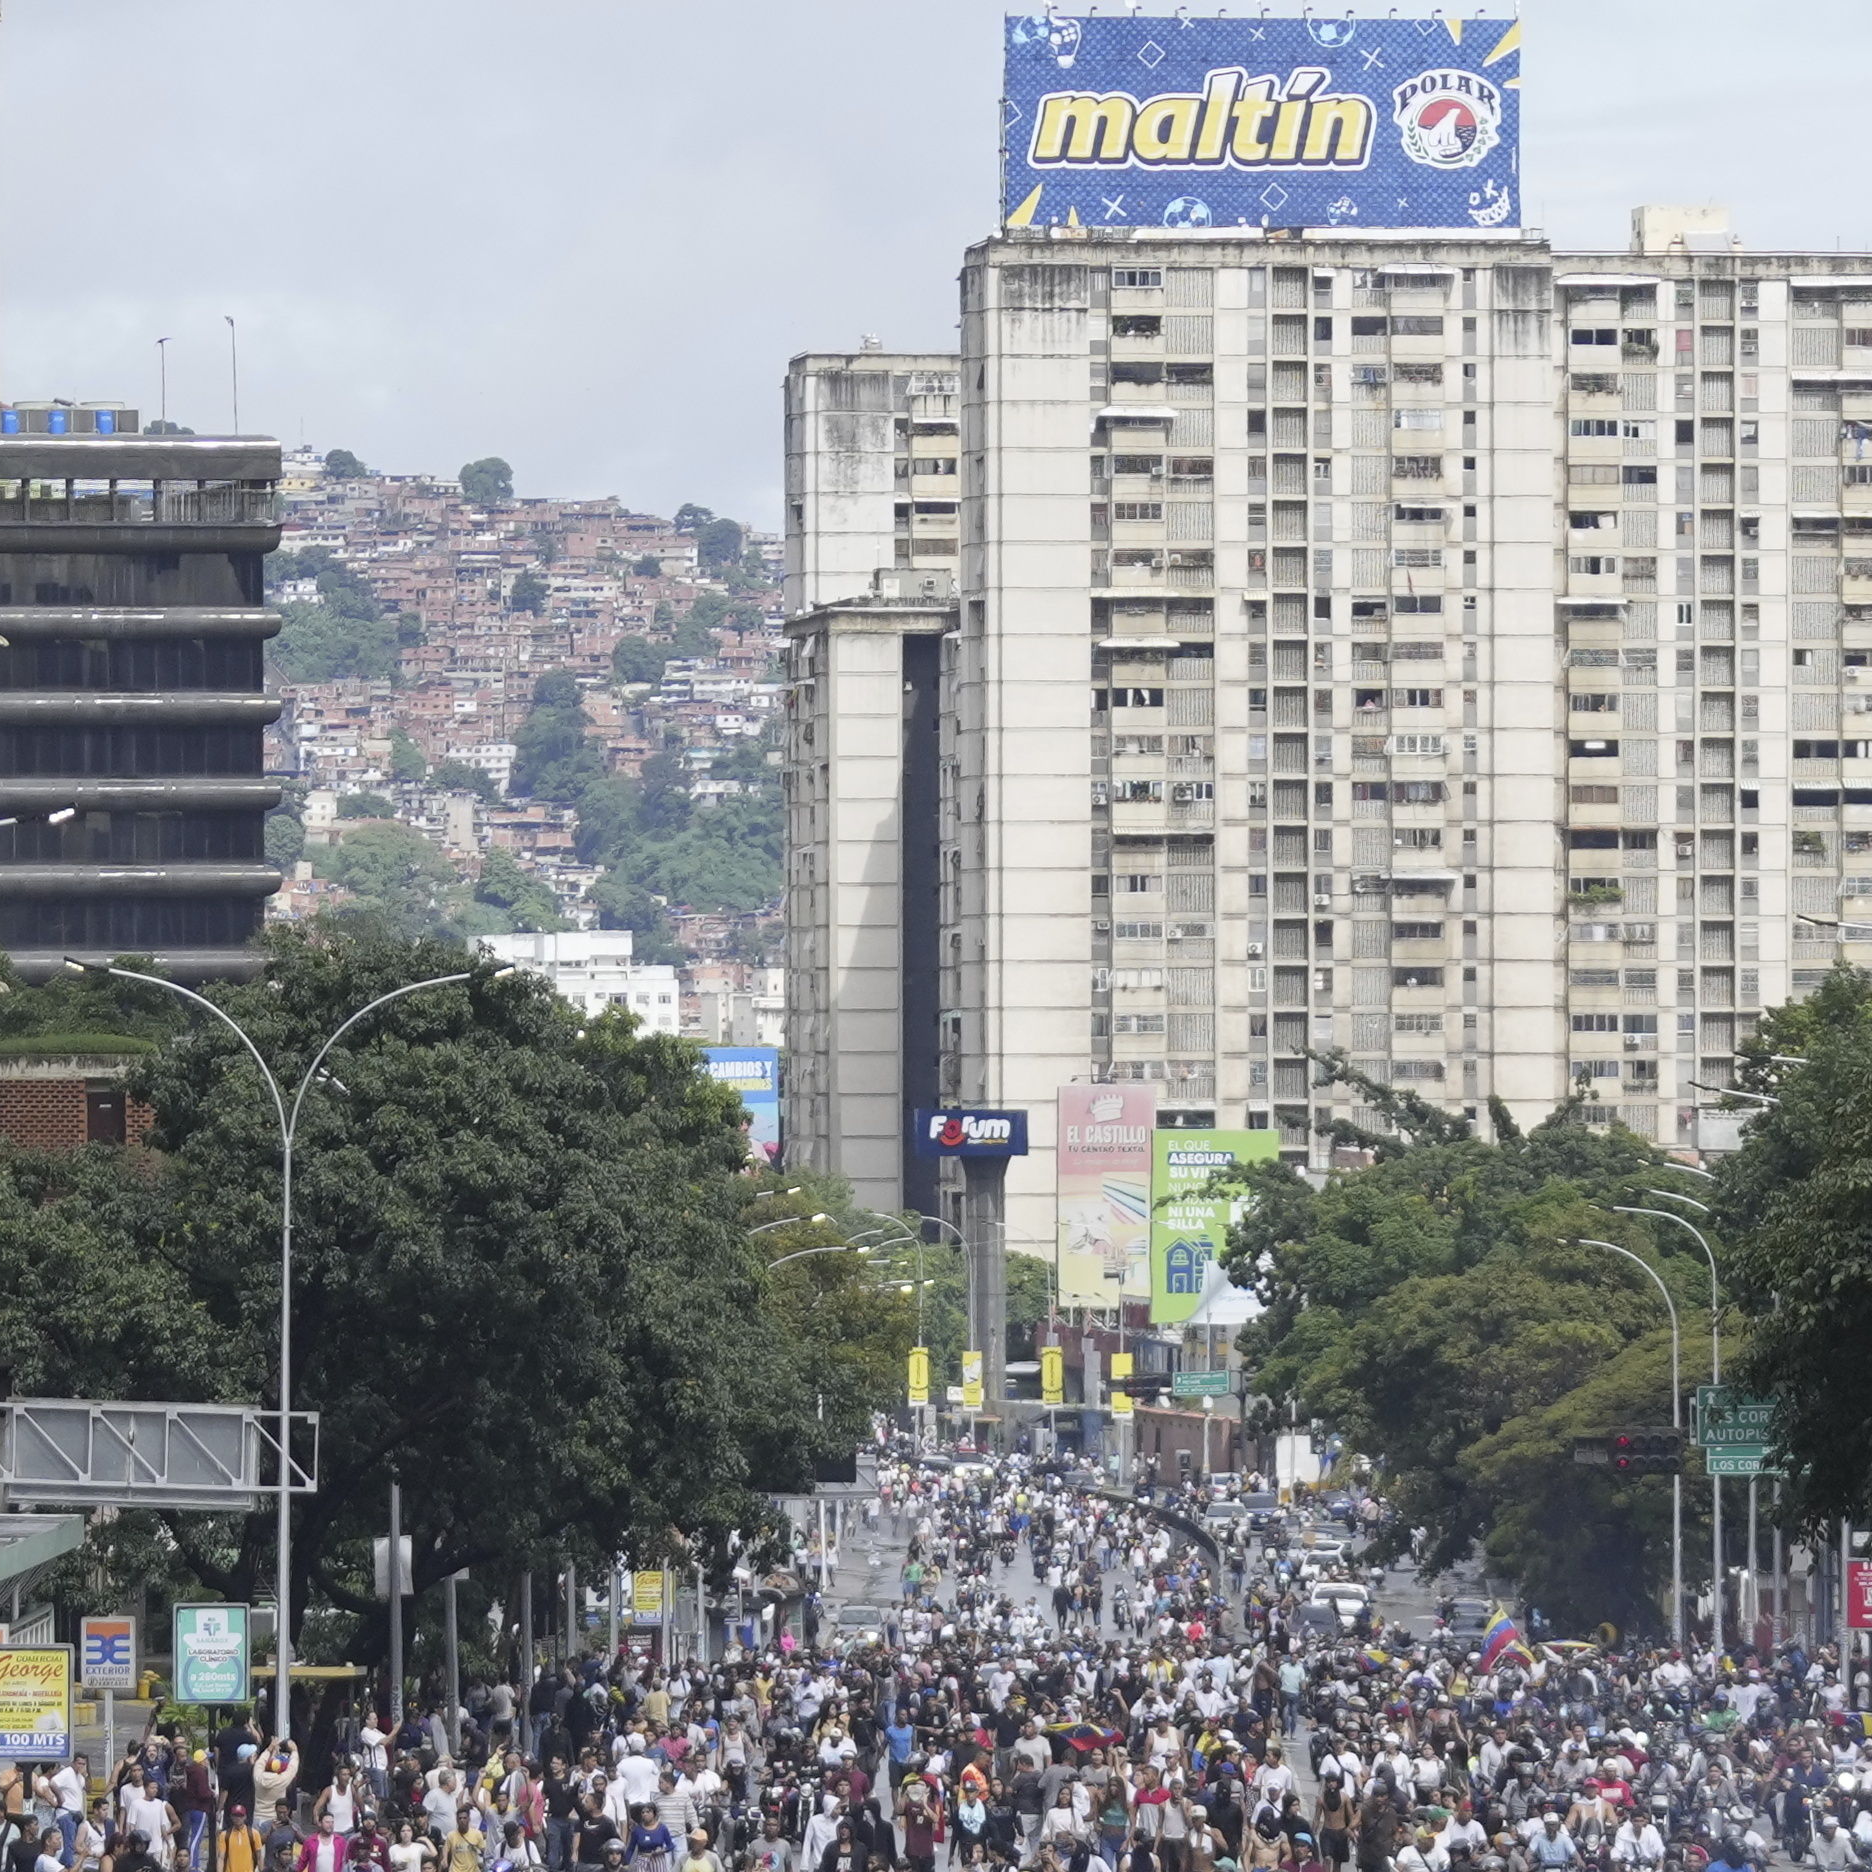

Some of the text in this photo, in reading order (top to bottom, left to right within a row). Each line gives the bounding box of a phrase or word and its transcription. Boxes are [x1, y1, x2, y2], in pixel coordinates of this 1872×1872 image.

[1398, 69, 1498, 115] POLAR
[1032, 67, 1377, 170] maltín
[709, 1061, 773, 1078] CAMBIOS Y
[929, 1115, 1011, 1140] Forum
[1067, 1125, 1147, 1144] EL CASTILLO
[1168, 1140, 1210, 1151] EL QUE
[1169, 1152, 1232, 1164] ASEGURA
[1169, 1167, 1191, 1178] SU
[1168, 1206, 1215, 1217] NI UNA
[1168, 1219, 1205, 1230] SILLA
[1713, 1461, 1734, 1470] LOS
[16, 1655, 64, 1663] COMERCIAL
[85, 1666, 131, 1675] EXTERIOR
[4, 1733, 30, 1744] 100
[33, 1733, 65, 1744] MTS
